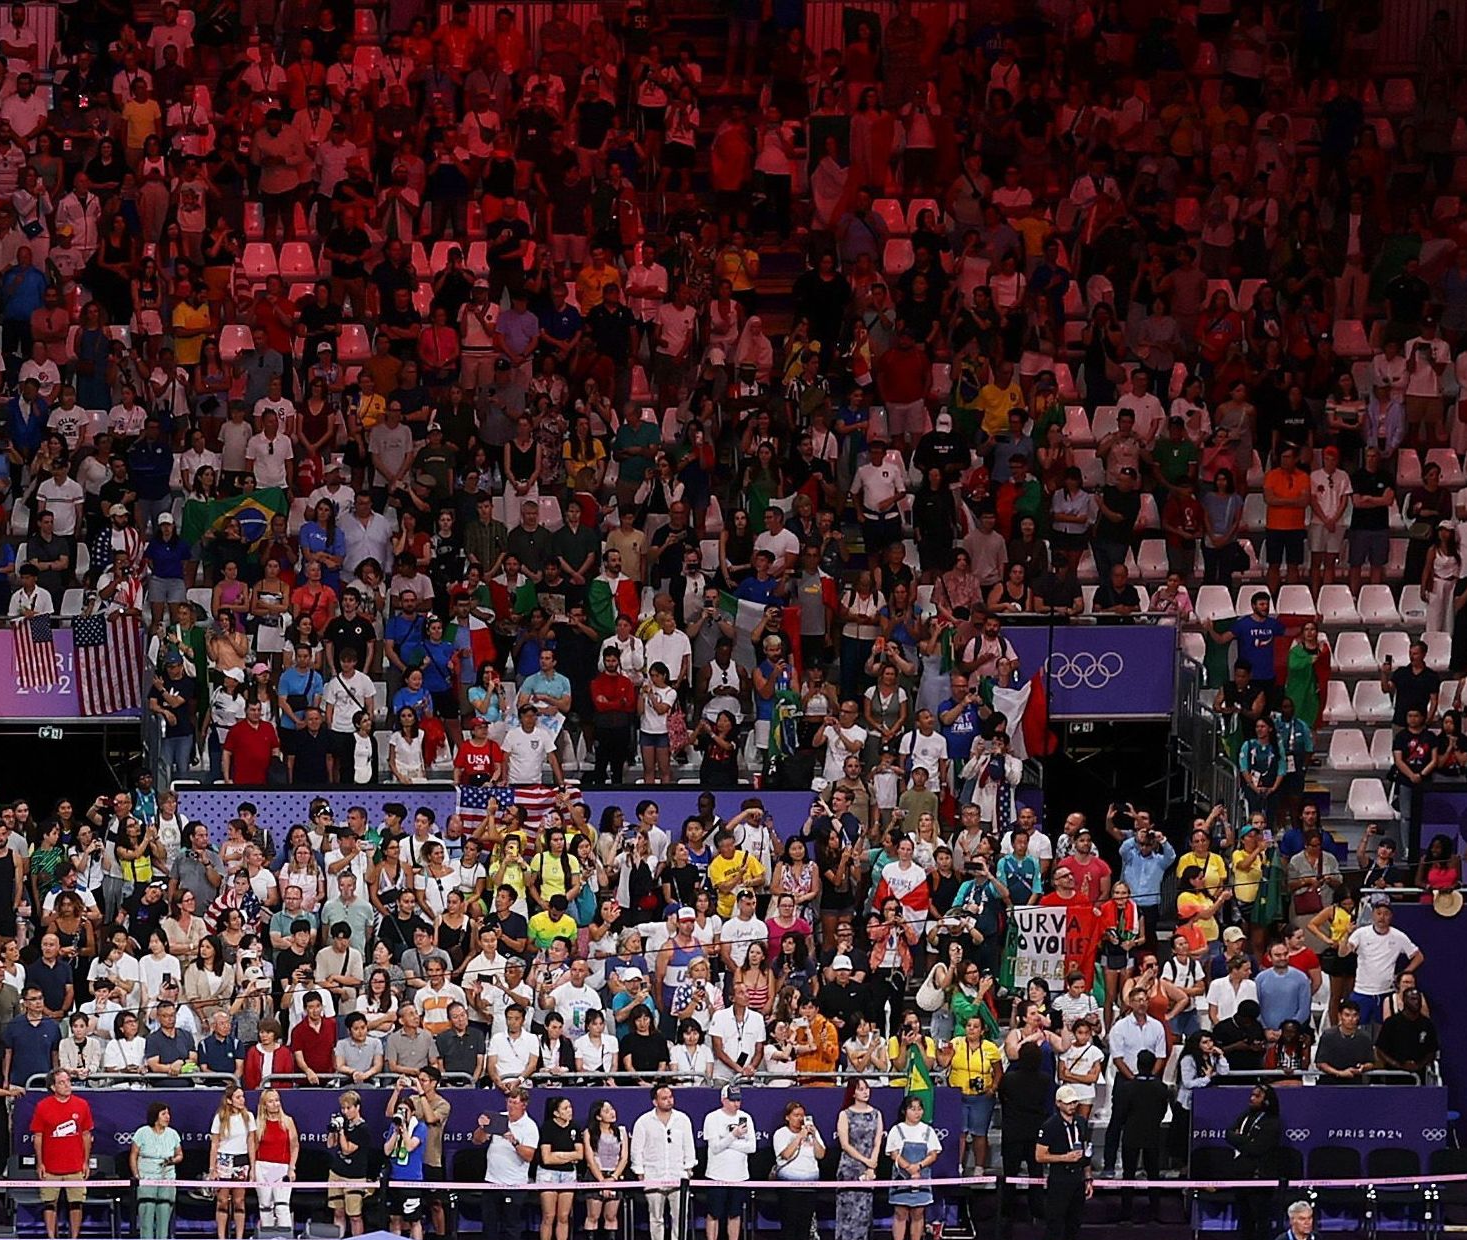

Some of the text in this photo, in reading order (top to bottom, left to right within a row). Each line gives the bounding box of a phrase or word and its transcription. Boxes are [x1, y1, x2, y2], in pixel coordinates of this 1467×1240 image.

[466, 755, 491, 765] USA
[1019, 913, 1081, 933] URVA
[299, 1133, 328, 1142] ARIS
[1327, 1129, 1402, 1139] PARIS 2024
